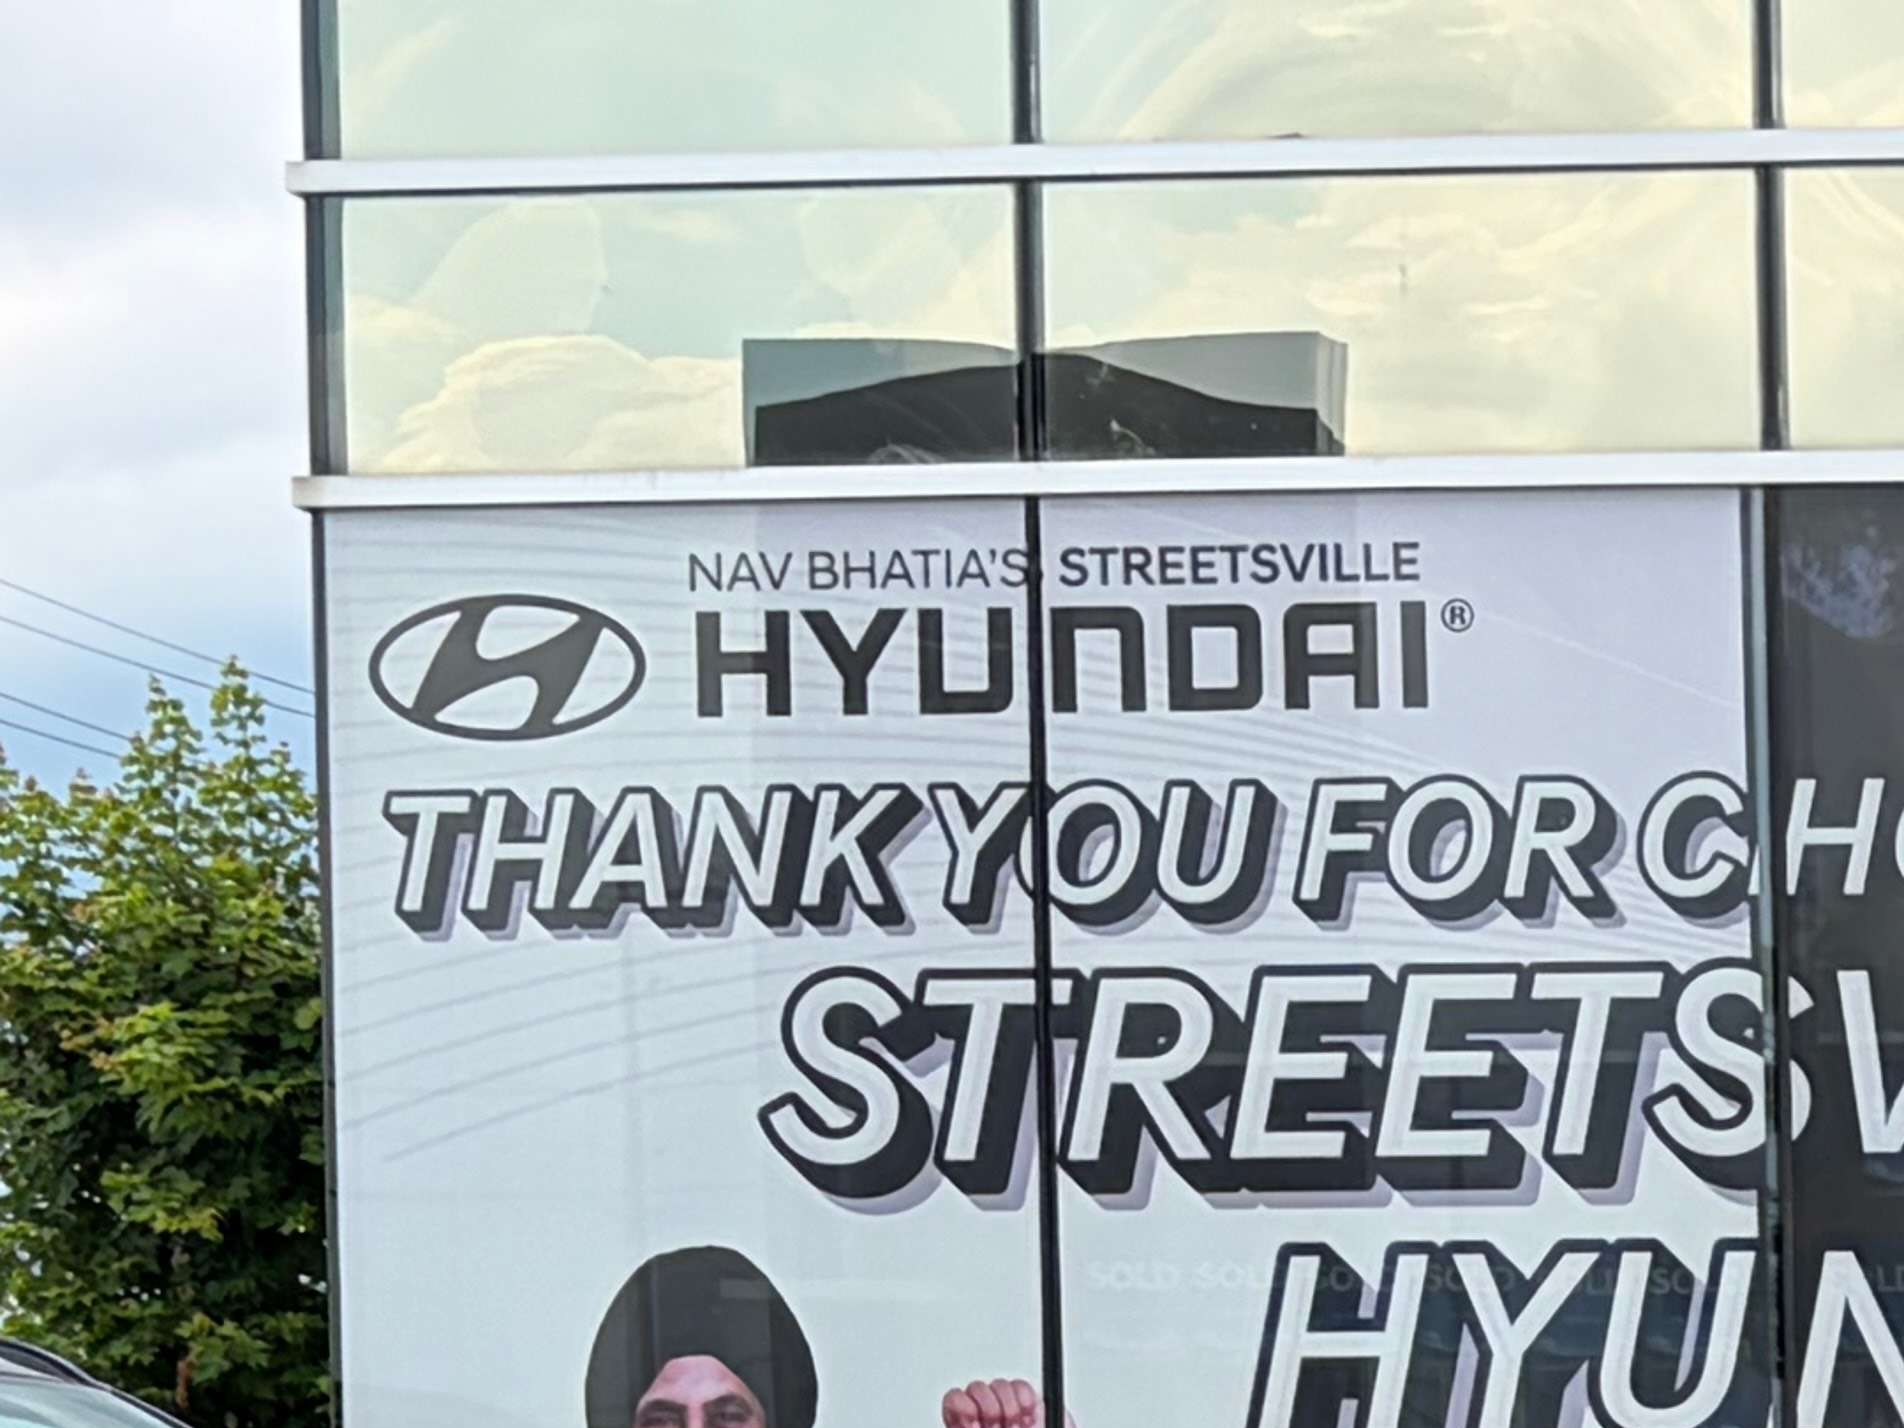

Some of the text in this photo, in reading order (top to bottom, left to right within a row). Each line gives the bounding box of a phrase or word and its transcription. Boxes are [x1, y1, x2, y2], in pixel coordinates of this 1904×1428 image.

[688, 540, 1422, 594] NAV BHATIA'S STREETSVILLE
[695, 600, 1430, 718] HYUNDAI
[385, 785, 920, 932] THANK
[915, 782, 1288, 928] YOU
[1295, 774, 1630, 926] FOR
